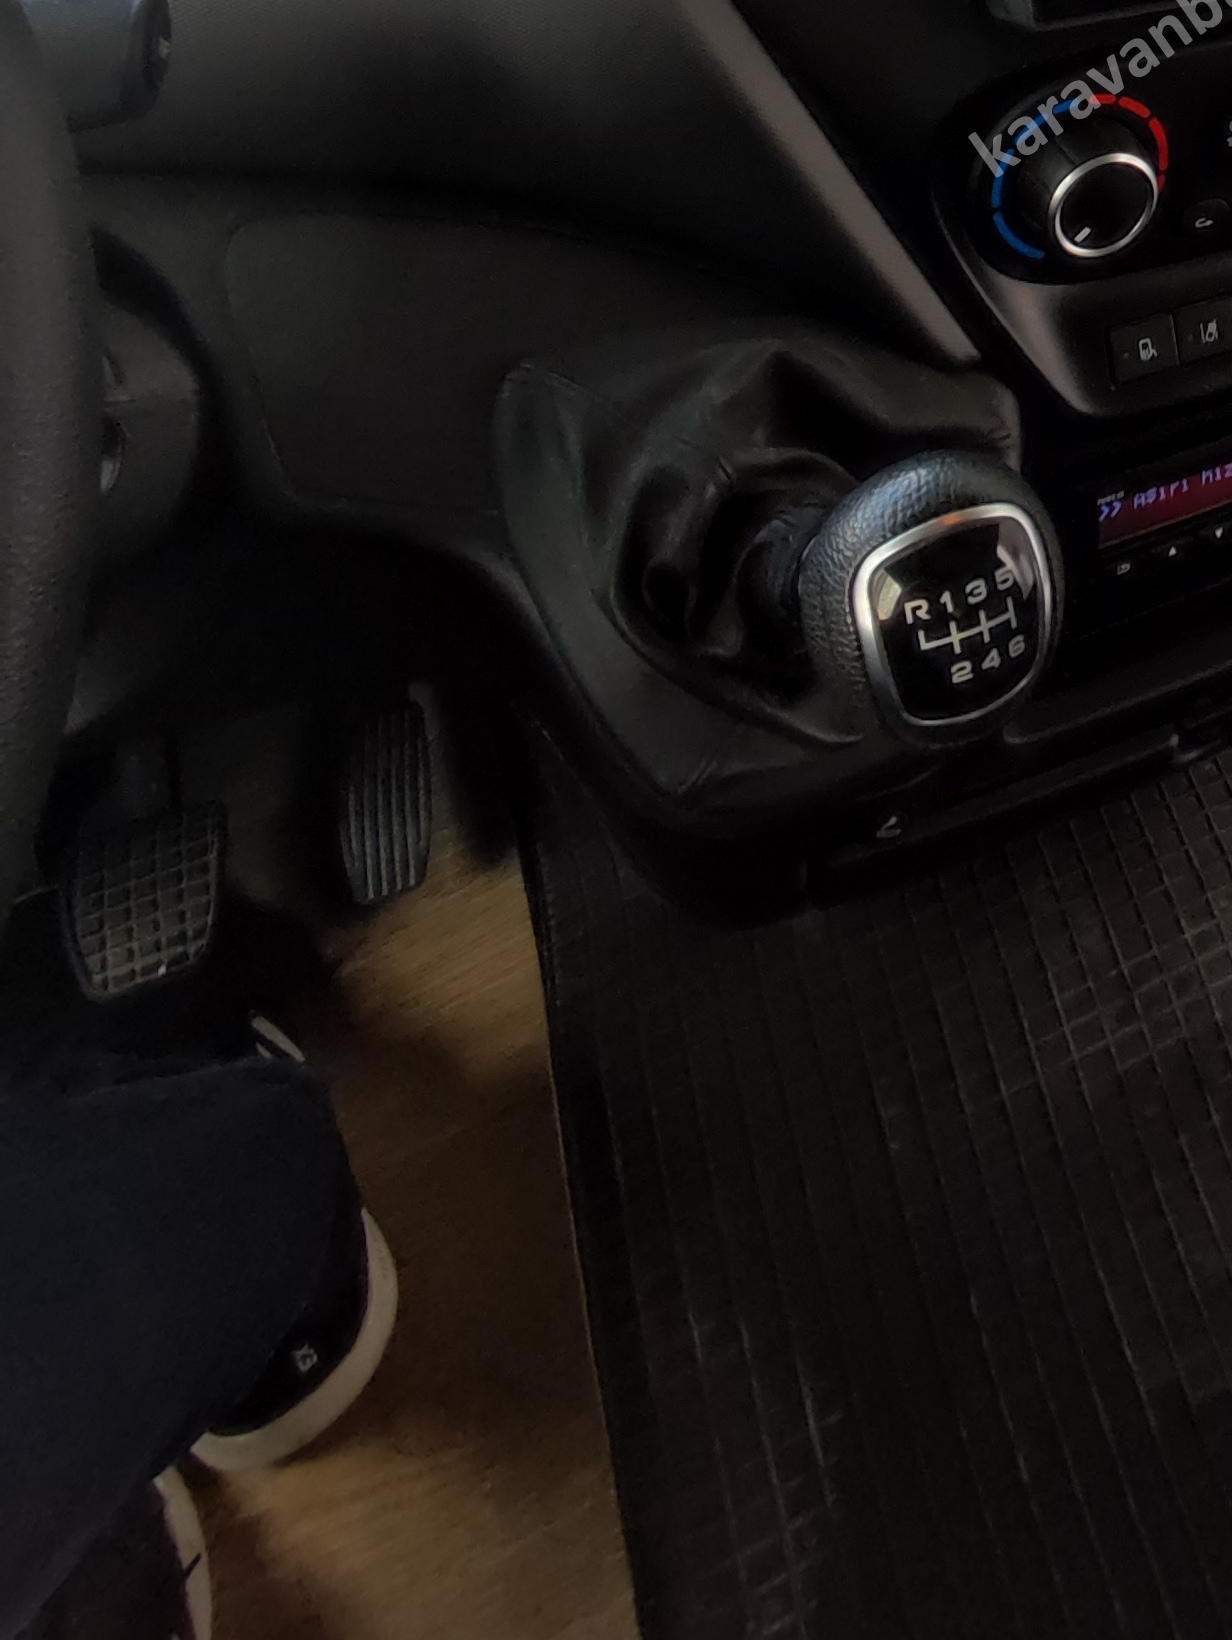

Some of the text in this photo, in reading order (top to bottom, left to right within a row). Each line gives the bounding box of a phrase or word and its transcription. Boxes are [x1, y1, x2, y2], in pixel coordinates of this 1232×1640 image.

[904, 567, 1016, 625] R 1 3 5
[950, 633, 1026, 684] 2 4 6
